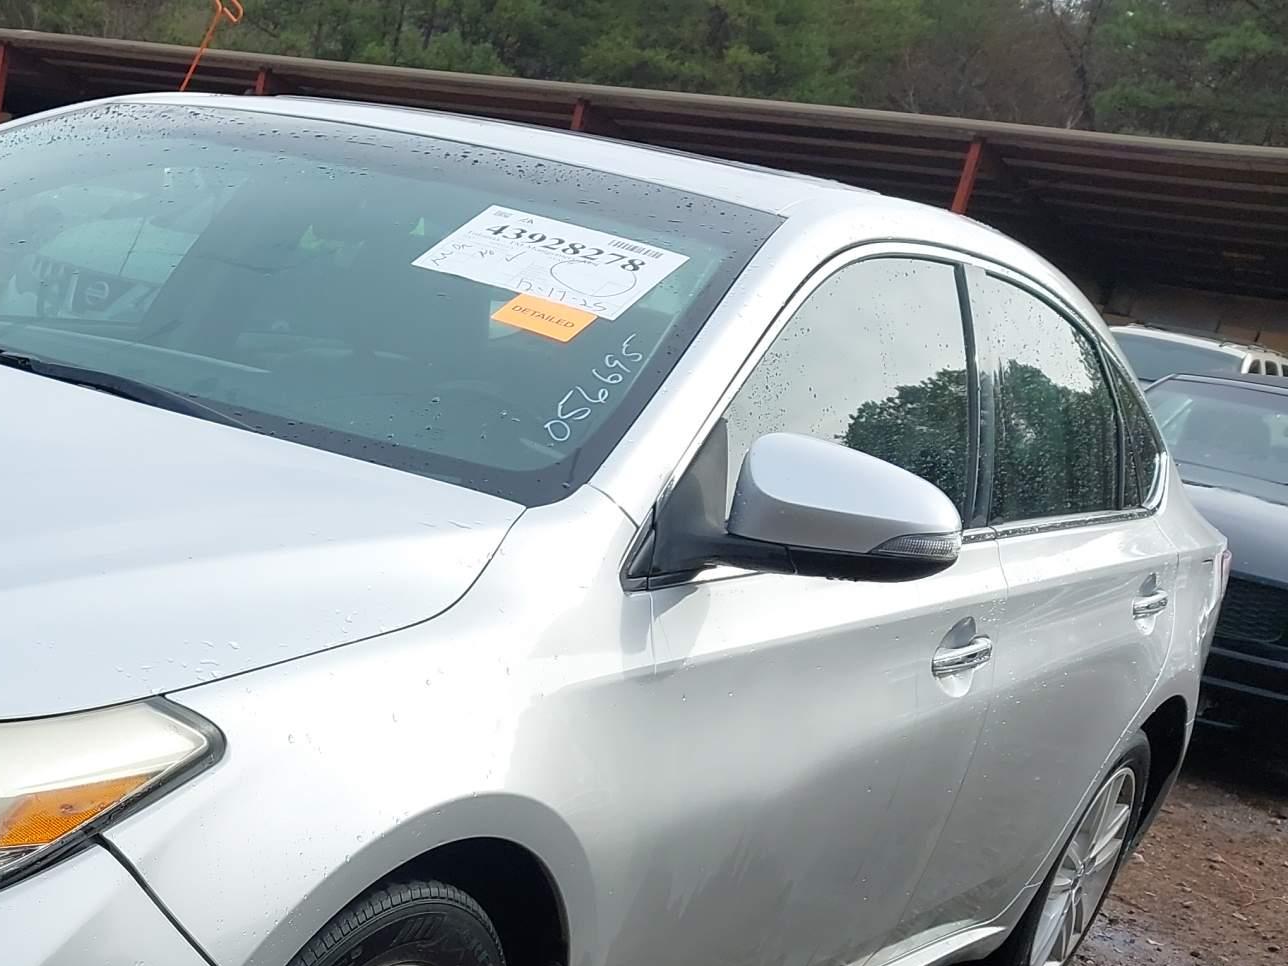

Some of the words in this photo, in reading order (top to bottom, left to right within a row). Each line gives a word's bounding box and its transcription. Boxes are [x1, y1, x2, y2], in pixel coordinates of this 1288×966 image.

[485, 224, 646, 272] 43928278
[511, 304, 575, 329] DETAILED
[544, 333, 643, 441] 056695
